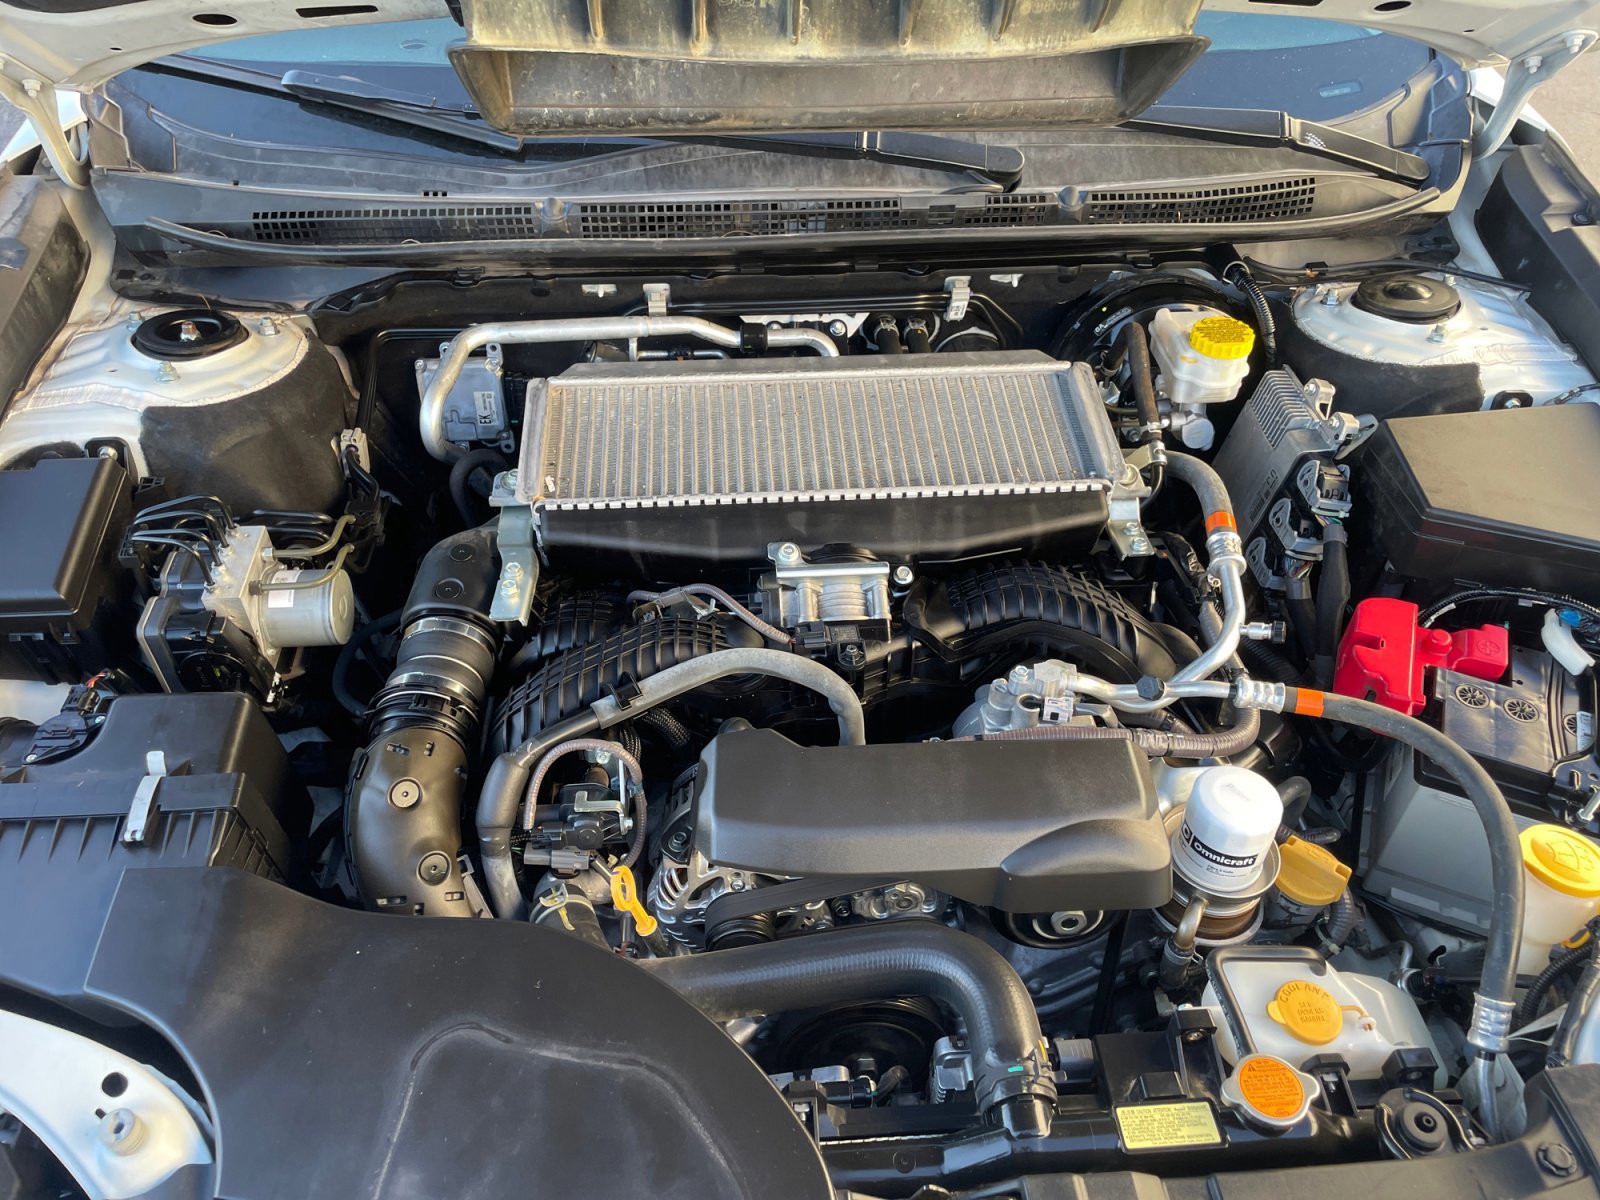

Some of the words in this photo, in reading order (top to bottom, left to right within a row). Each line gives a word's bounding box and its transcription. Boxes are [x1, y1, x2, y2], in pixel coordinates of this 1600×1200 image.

[478, 414, 491, 424] EK
[1194, 841, 1255, 866] Omnicraft
[1279, 982, 1329, 1004] COOLANT
